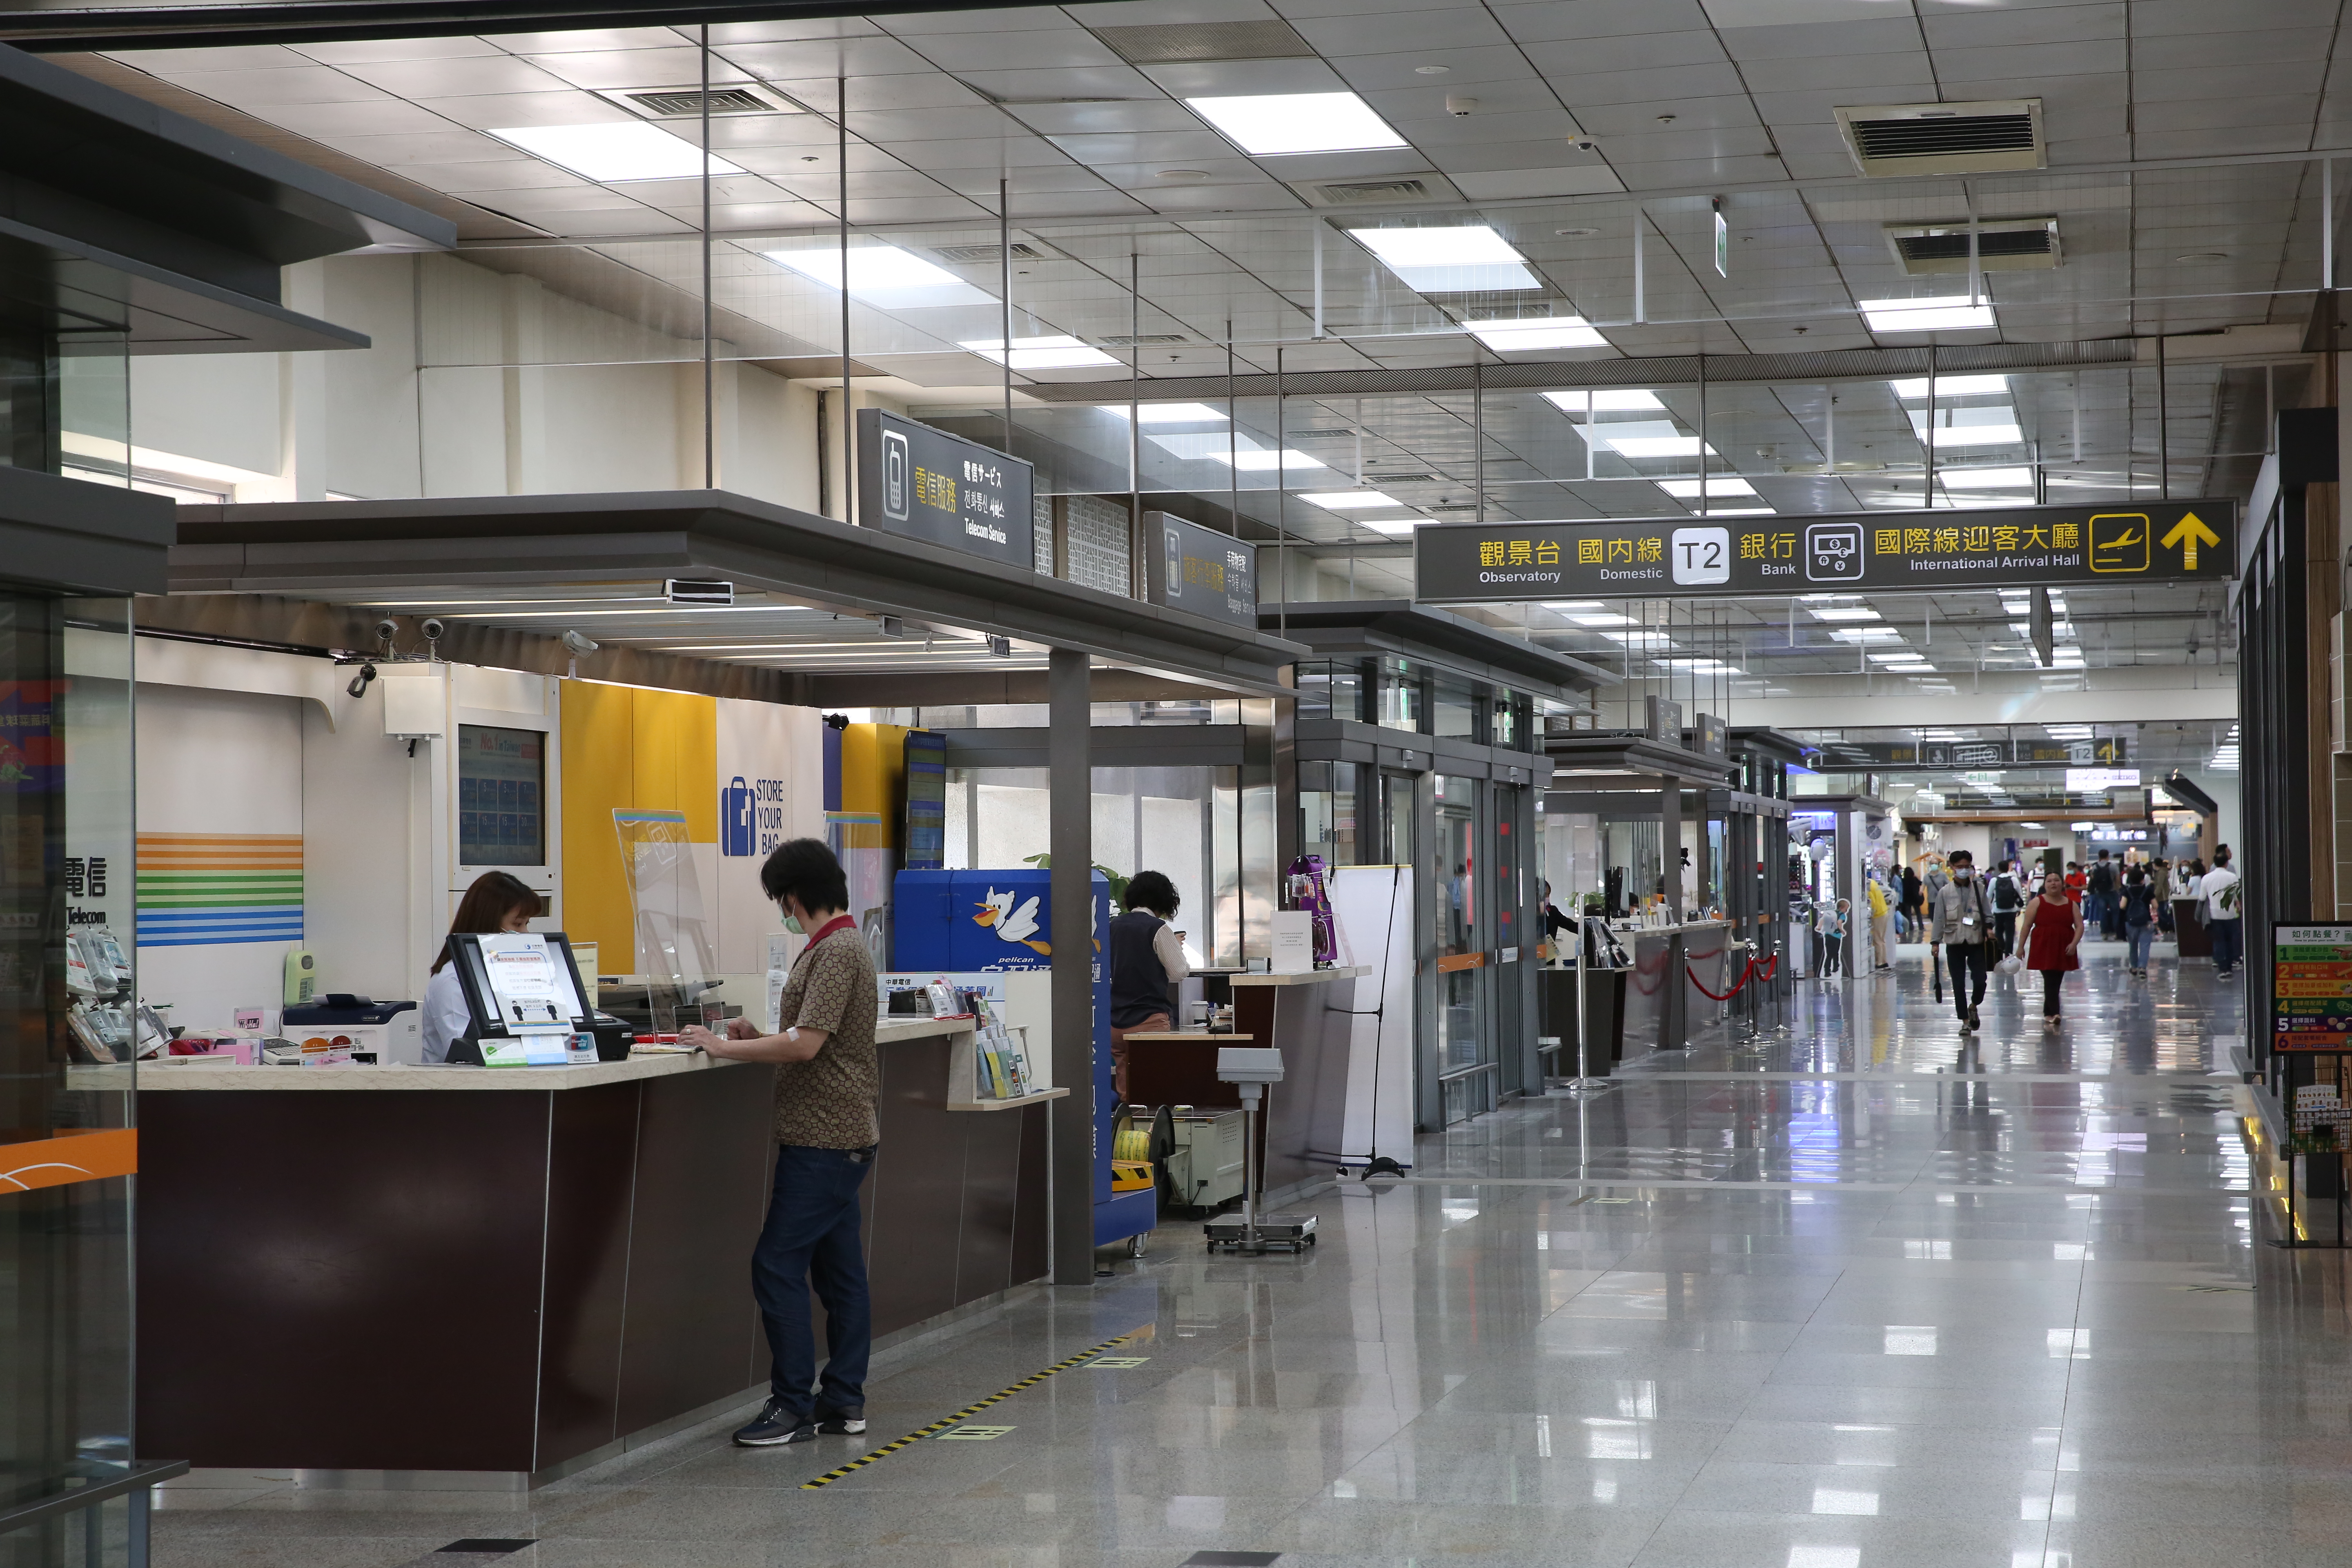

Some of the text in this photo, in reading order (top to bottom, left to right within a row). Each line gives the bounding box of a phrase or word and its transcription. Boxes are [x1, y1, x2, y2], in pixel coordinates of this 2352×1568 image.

[964, 460, 1002, 489] 電信サービス
[915, 466, 956, 513] 電信服務
[964, 489, 1005, 519] 전화통신 서비스
[964, 517, 1007, 545] Telecom Service
[1875, 523, 2080, 555] 國際線迎客大廳
[1479, 539, 1561, 567] 觀景台
[1740, 532, 1796, 559] 銀行
[1679, 541, 1722, 569] T2
[1910, 554, 2080, 571] International Arrival Hall
[1479, 570, 1561, 584] Observatory
[1600, 568, 1663, 580] Domestic
[1761, 563, 1796, 575] Bank
[1228, 593, 1256, 616] Baggage Service
[503, 740, 521, 753] Taiwan
[2073, 746, 2090, 759] T2
[757, 779, 783, 802] STORE
[758, 806, 782, 829] YOUR
[762, 833, 779, 855] BAG
[66, 906, 106, 924] Telecom
[2280, 947, 2289, 960] 1
[2278, 964, 2290, 978] 2
[2278, 982, 2289, 996] 3
[2277, 1000, 2290, 1013] 4
[2278, 1018, 2289, 1031] 5
[2278, 1035, 2289, 1049] 6
